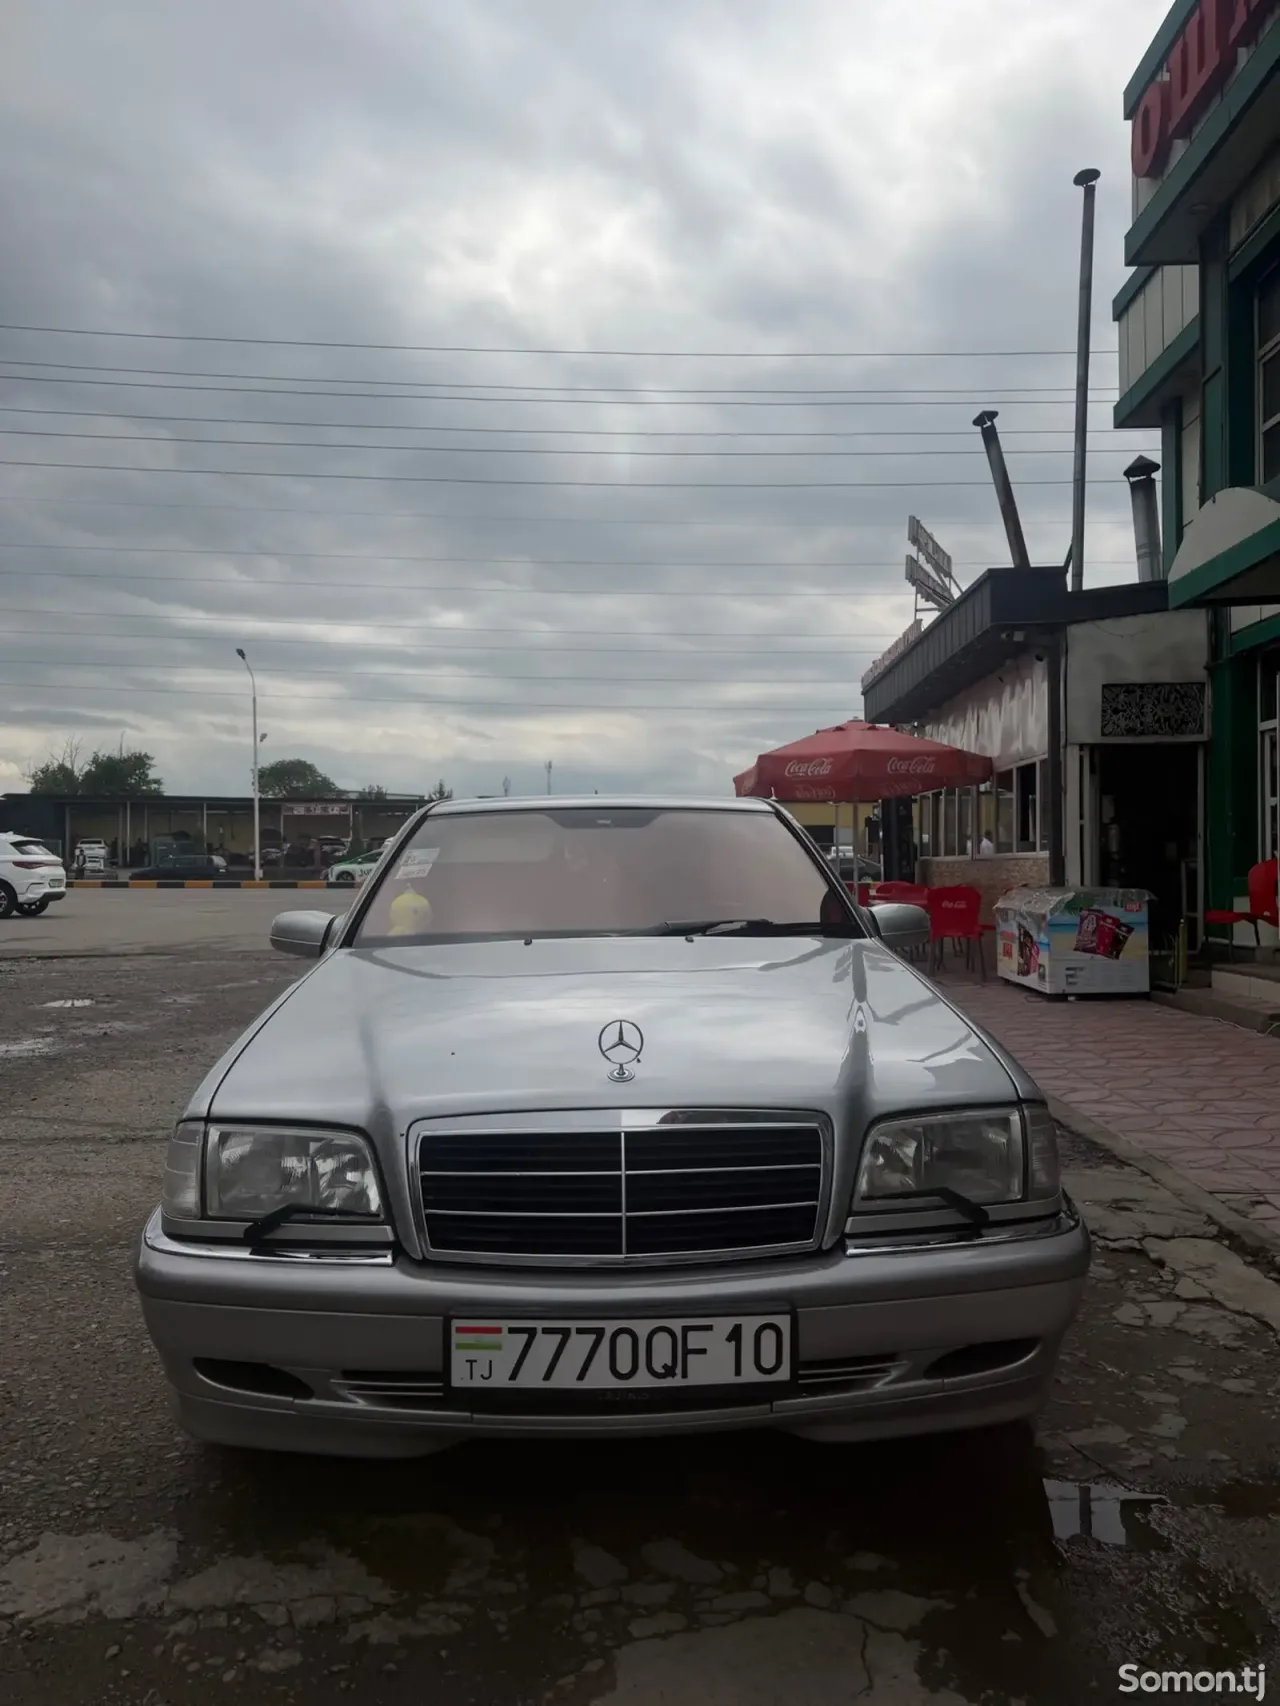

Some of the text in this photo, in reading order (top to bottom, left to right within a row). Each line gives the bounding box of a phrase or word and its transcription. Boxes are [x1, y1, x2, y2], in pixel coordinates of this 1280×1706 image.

[785, 757, 834, 777] Coca-Cola
[887, 756, 936, 774] Coca-Cola
[465, 1359, 492, 1381] TJ
